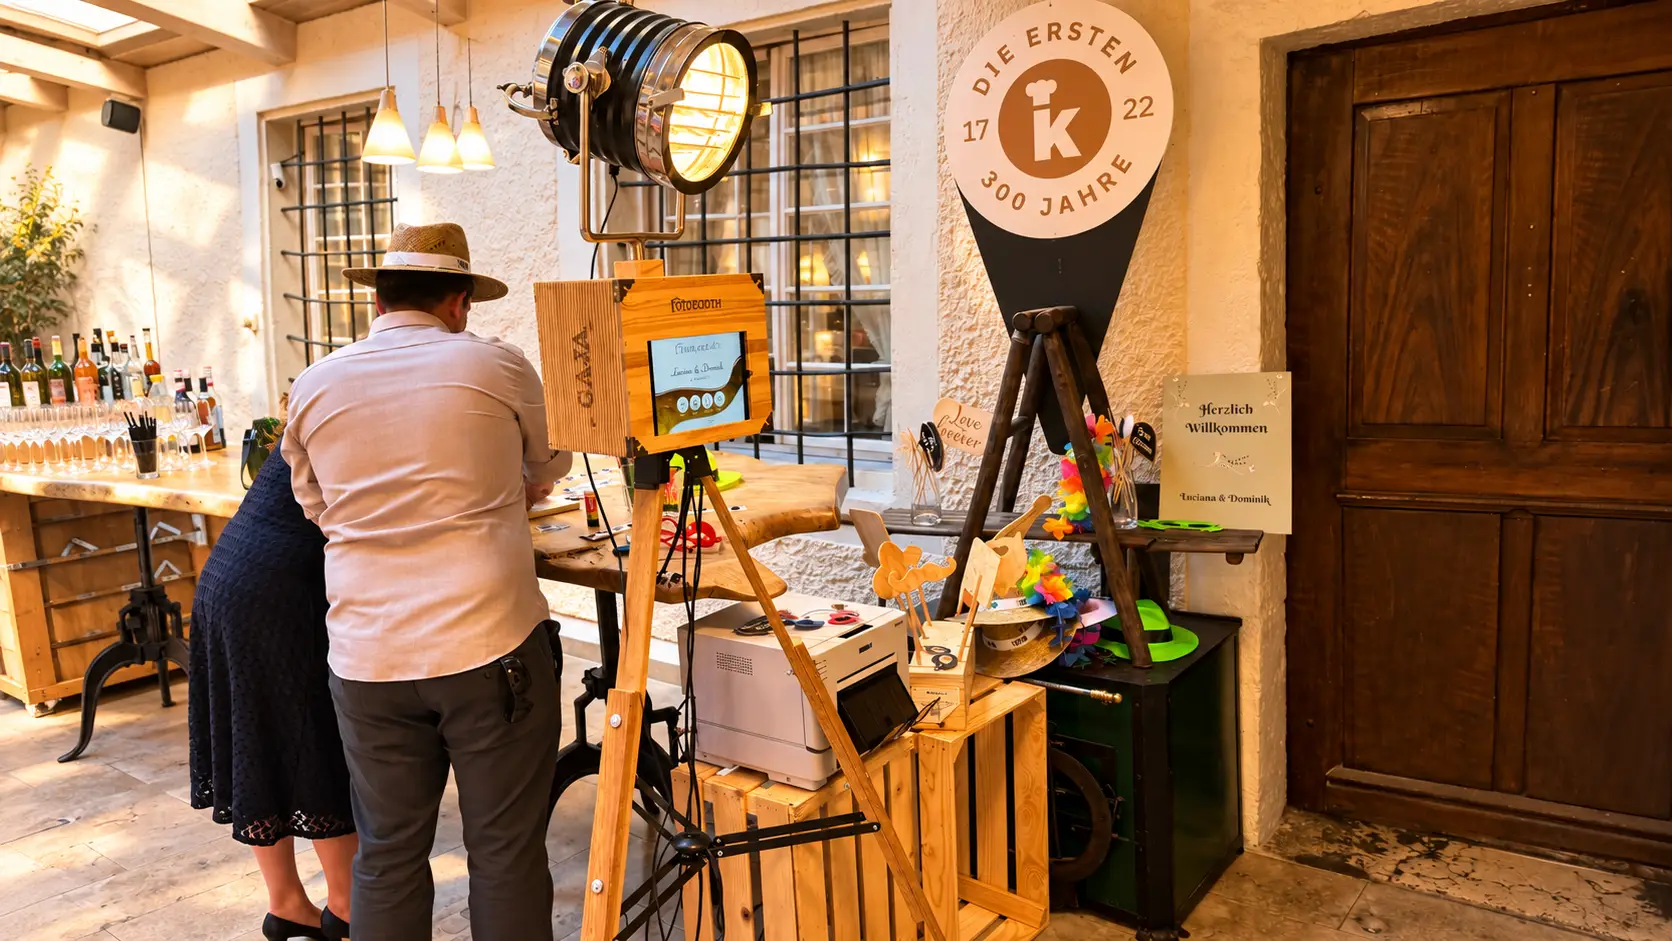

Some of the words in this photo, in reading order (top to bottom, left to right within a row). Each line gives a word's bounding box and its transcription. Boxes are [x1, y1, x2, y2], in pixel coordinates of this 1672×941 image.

[972, 44, 1015, 96] DIE
[1026, 21, 1137, 74] ERSTEN
[1122, 95, 1154, 120] 22
[963, 118, 989, 142] 17
[980, 170, 1026, 211] 300
[1039, 154, 1133, 216] JAHRE
[949, 404, 983, 432] Love
[1199, 401, 1253, 417] Herzlich
[1185, 422, 1268, 435] Willkommen
[1179, 492, 1216, 502] Luciana
[1218, 494, 1226, 503] &
[1227, 493, 1272, 506] Dominik
